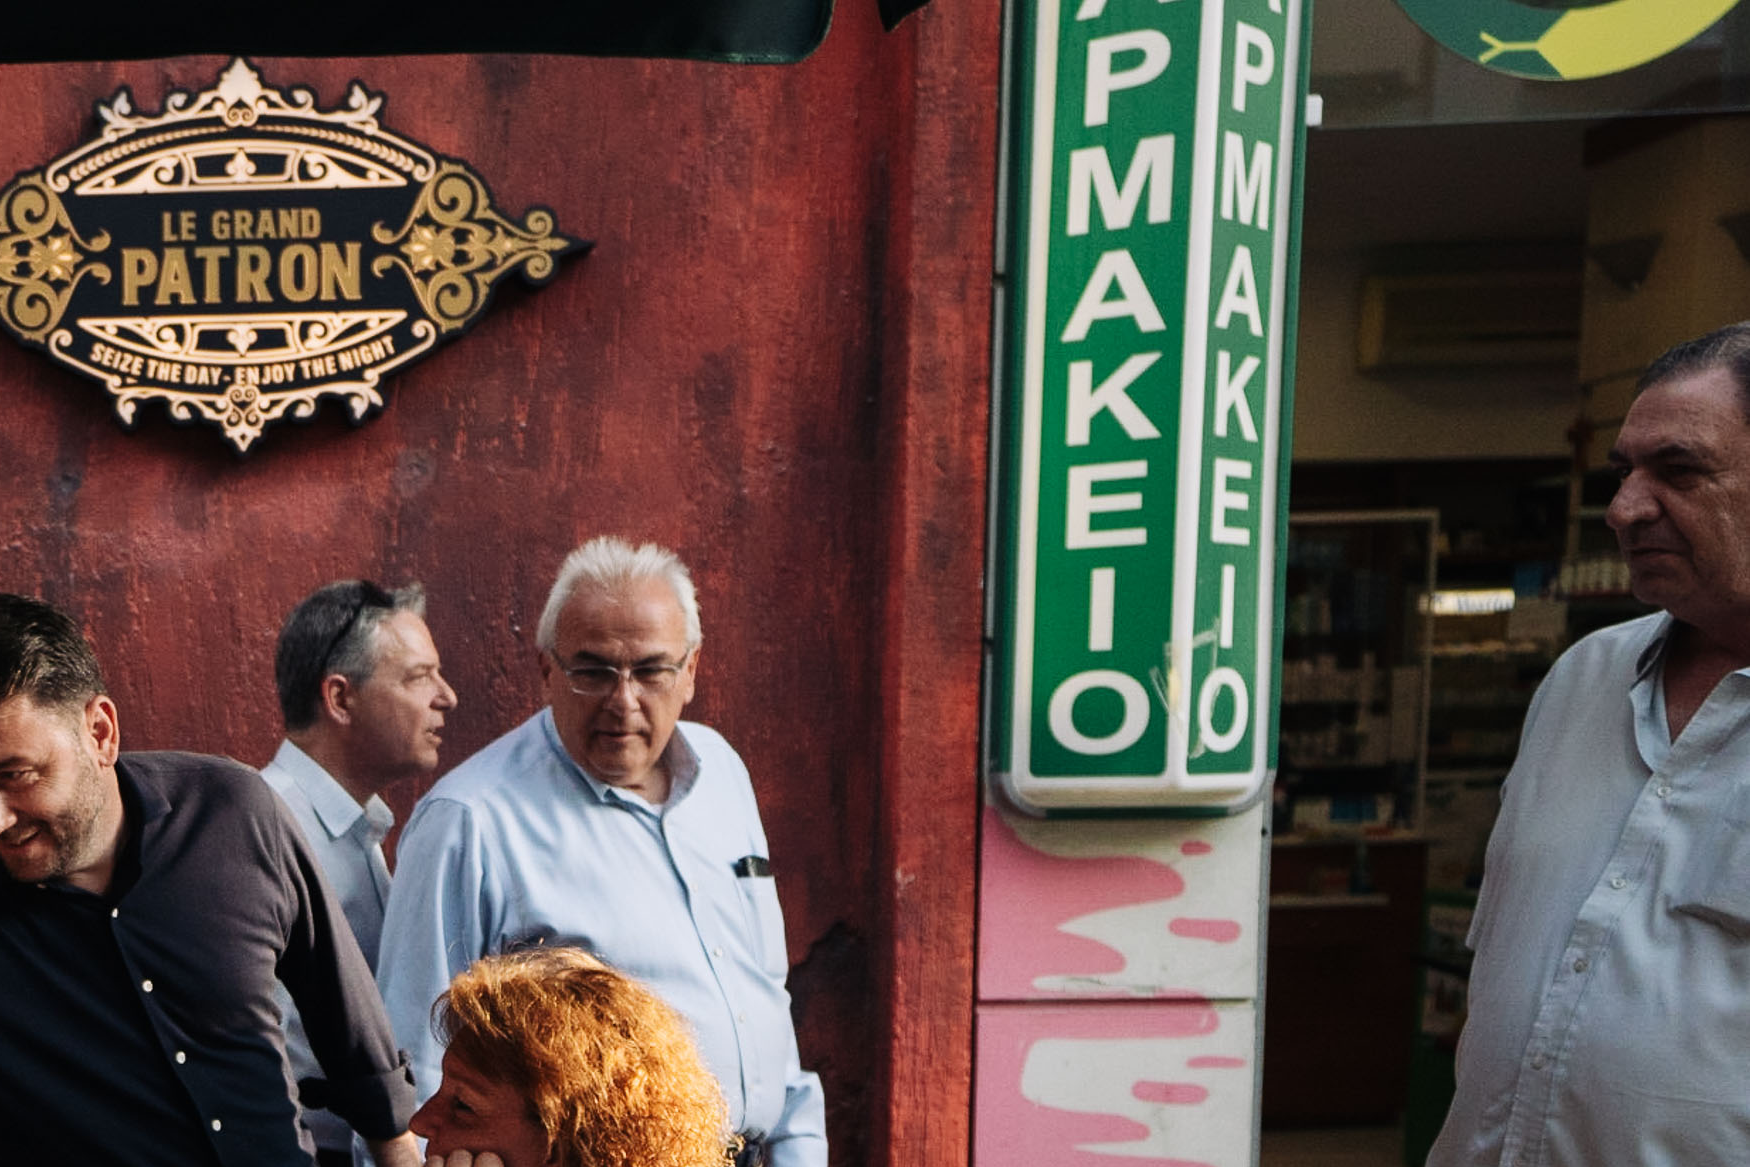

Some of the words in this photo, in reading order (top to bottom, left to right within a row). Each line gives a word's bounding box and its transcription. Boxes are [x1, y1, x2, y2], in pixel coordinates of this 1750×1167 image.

[162, 210, 197, 242] LE
[213, 208, 321, 241] GRAND
[121, 242, 363, 306] PATRON
[90, 342, 144, 376] SEIZE
[146, 361, 182, 384] THE
[184, 365, 222, 386] DAY
[233, 363, 296, 386] ENJOY
[300, 355, 338, 380] THE
[337, 335, 396, 372] NIGHT
[1048, 0, 1176, 756] ΡΜΑΚΕΙΟ
[1198, 0, 1283, 754] ΡΜΑΚΕΙΟ
